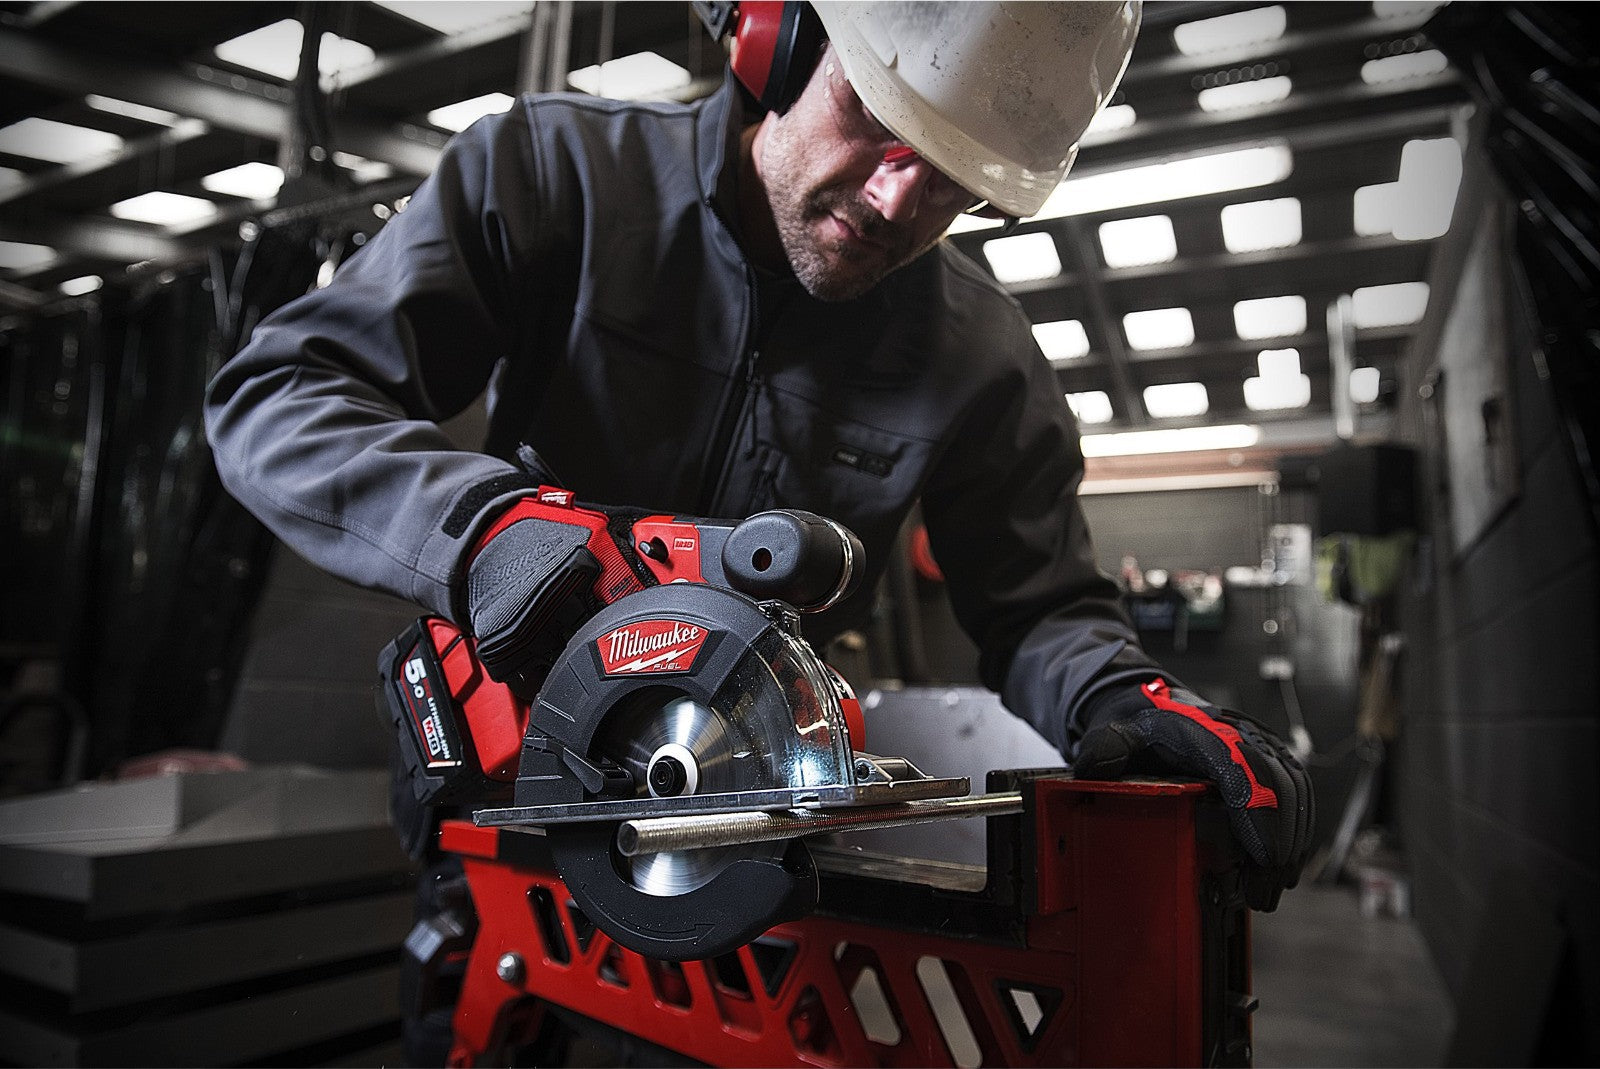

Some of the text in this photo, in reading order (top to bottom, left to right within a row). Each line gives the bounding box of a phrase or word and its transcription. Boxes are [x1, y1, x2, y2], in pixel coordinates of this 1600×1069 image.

[605, 622, 700, 664] Milwaukee
[404, 658, 427, 699] 5.0
[653, 662, 682, 671] FUEL
[421, 678, 451, 760] LITHIUM-ION
[424, 720, 439, 751] M18
